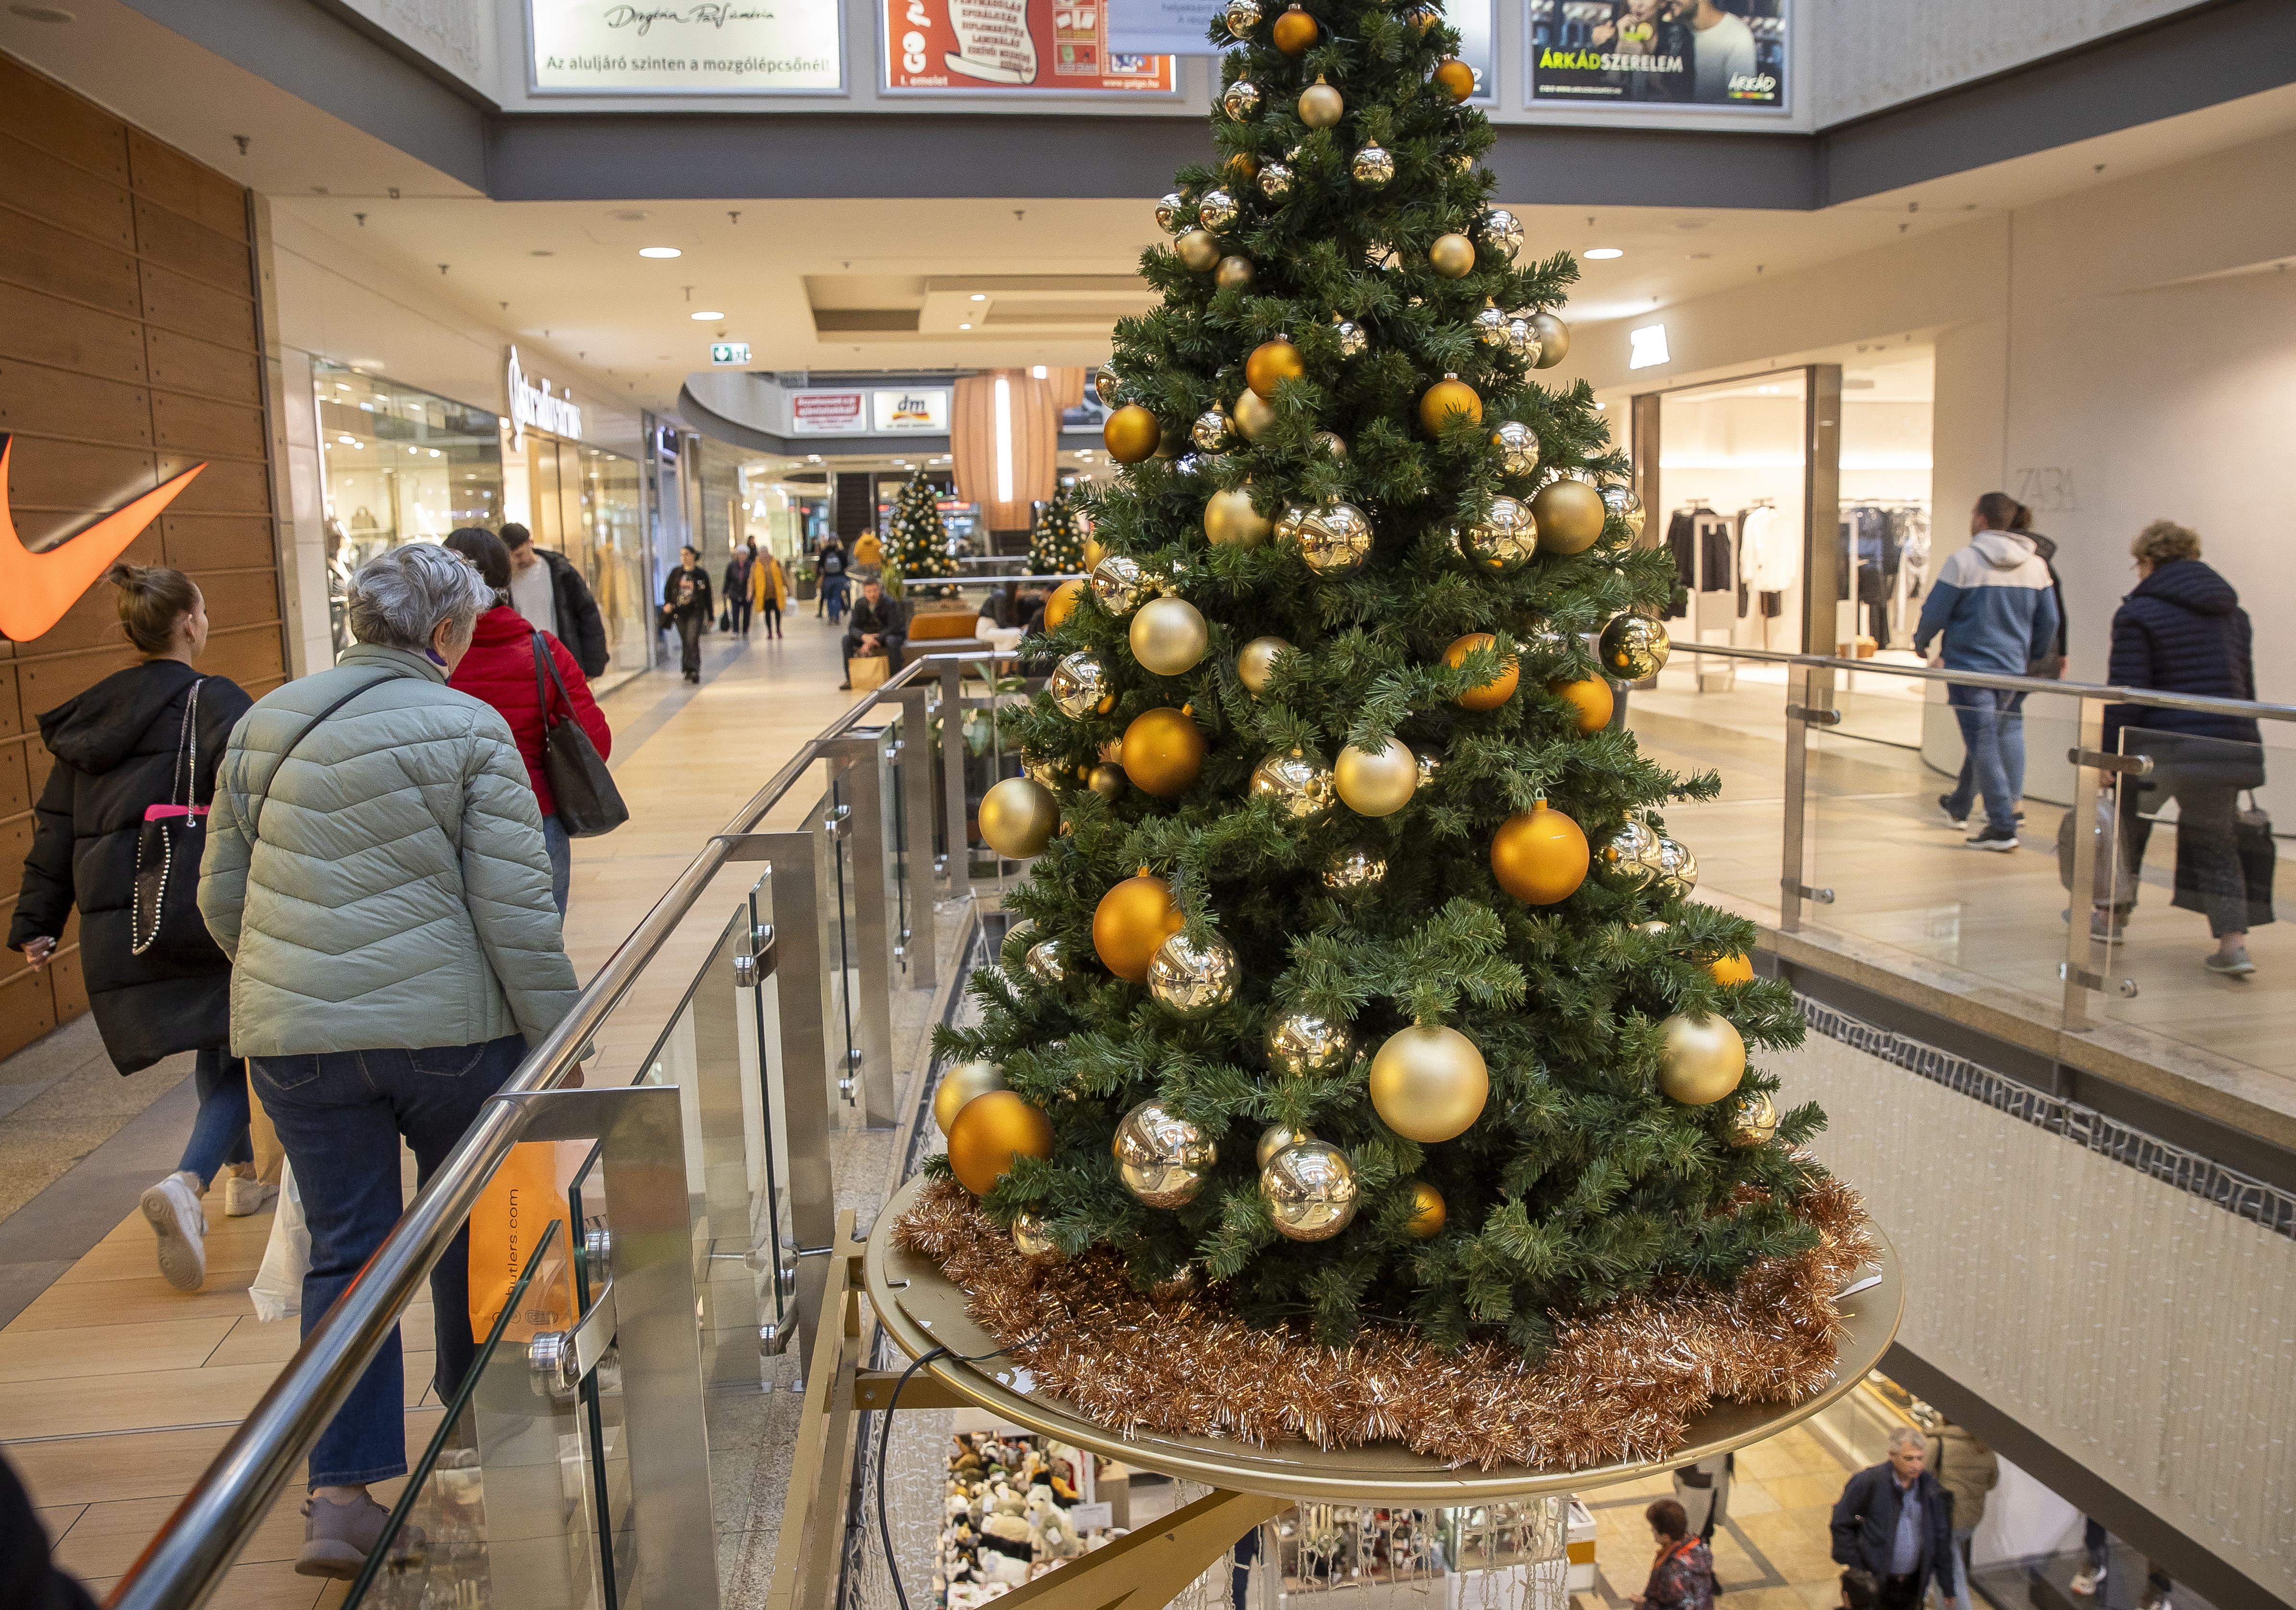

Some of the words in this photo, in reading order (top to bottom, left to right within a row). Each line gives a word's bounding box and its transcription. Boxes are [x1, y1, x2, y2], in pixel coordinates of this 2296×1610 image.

[547, 55, 565, 71] Az
[569, 54, 627, 74] aluljáró
[631, 55, 686, 72] szinten
[690, 59, 699, 72] a
[897, 394, 925, 412] dm
[505, 1188, 519, 1297] butlers.com
